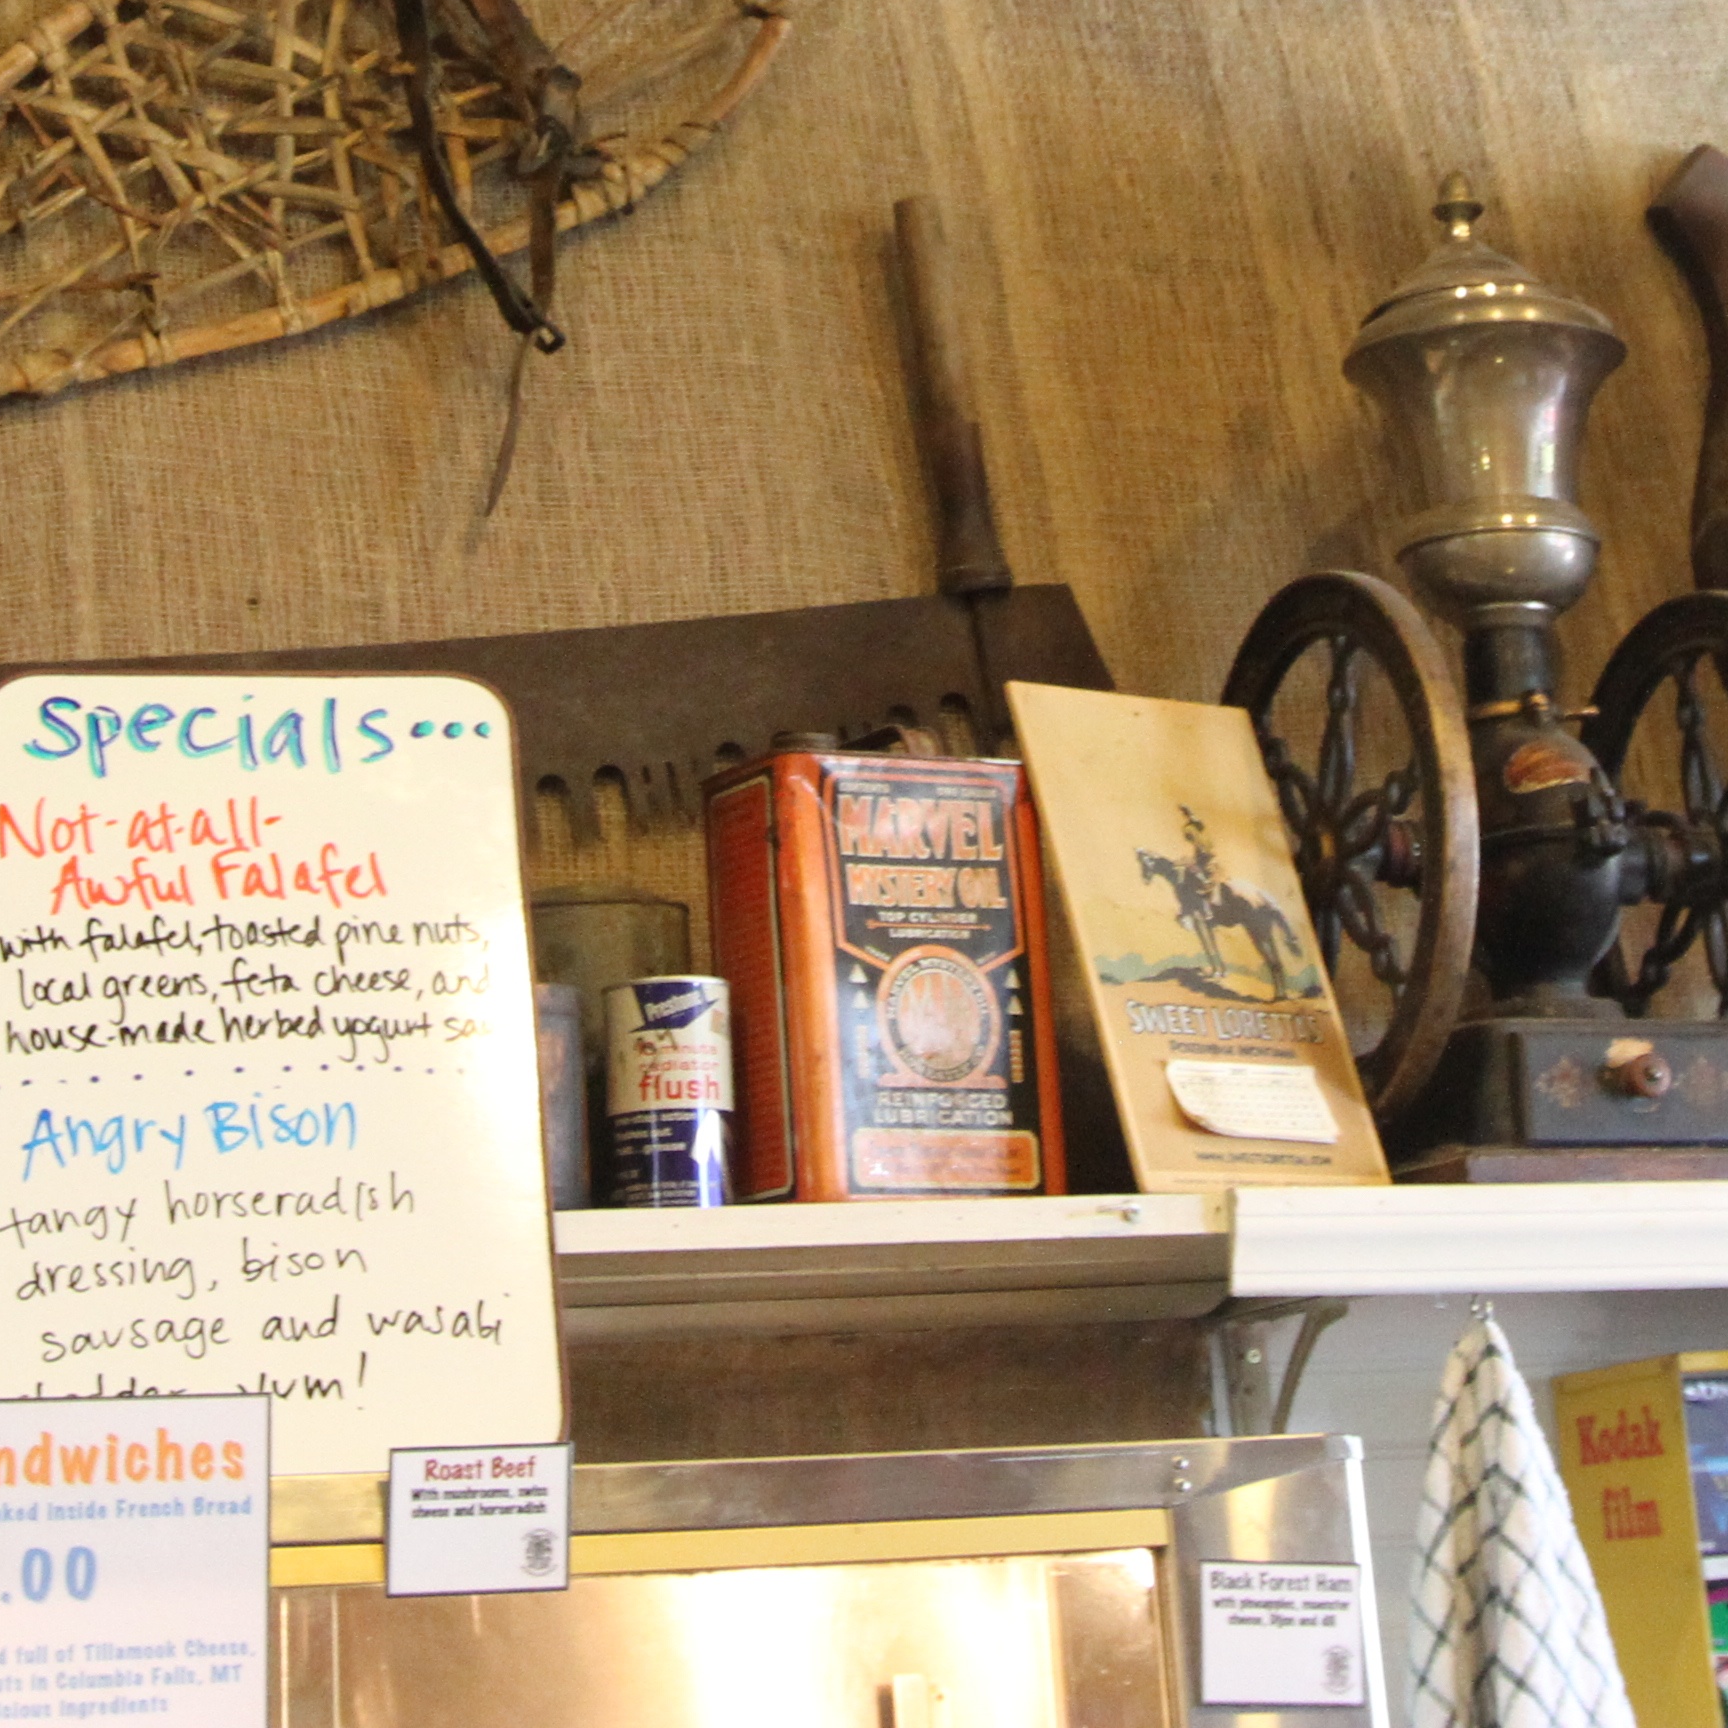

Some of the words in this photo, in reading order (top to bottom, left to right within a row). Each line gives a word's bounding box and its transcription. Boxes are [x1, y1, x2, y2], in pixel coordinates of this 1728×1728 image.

[838, 794, 1004, 861] MARVEL
[50, 855, 194, 915] Awful
[211, 842, 387, 908] Falafel
[845, 863, 957, 908] MYSTERY
[958, 867, 1008, 909] OIL
[79, 917, 204, 963] falafel,
[200, 915, 322, 950] toasted
[335, 918, 402, 966] pine
[413, 915, 489, 950] nuts,
[19, 968, 90, 1010] local
[103, 971, 219, 1025] greens,
[221, 958, 301, 1003] feta
[314, 964, 423, 1001] cheese,
[432, 966, 491, 996] and
[644, 989, 703, 1022] Prestone
[5, 1012, 216, 1055] house-made
[219, 1005, 324, 1046] herbed
[332, 1011, 433, 1063] yogurt
[1127, 1000, 1207, 1037] SWEET
[639, 1059, 720, 1073] radiator
[660, 1043, 718, 1056] minute
[638, 1074, 721, 1102] flush
[877, 1091, 1008, 1109] REINFORCED
[874, 1109, 1014, 1126] LUBRICATION
[21, 1108, 186, 1182] Angry
[203, 1092, 357, 1155] Bison
[163, 1170, 415, 1225] horseradish
[15, 1246, 219, 1302] dressing,
[240, 1236, 370, 1281] bison
[40, 1313, 231, 1364] sausage
[261, 1293, 340, 1342] and
[367, 1292, 513, 1345] wasabi
[1575, 1405, 1664, 1466] Kodak
[425, 1459, 484, 1481] Roast
[492, 1455, 536, 1479] Beef
[115, 1497, 184, 1519] French
[193, 1495, 253, 1516] Bread
[454, 1504, 475, 1517] and
[1602, 1486, 1663, 1541] film
[1210, 1571, 1253, 1590] Black
[1259, 1571, 1310, 1591] Forest
[1316, 1573, 1353, 1592] Ham
[15, 1645, 49, 1666] full
[56, 1644, 76, 1663] of
[83, 1640, 177, 1663] Tillamook
[56, 1668, 144, 1690] Columbia
[210, 1663, 244, 1683] MT
